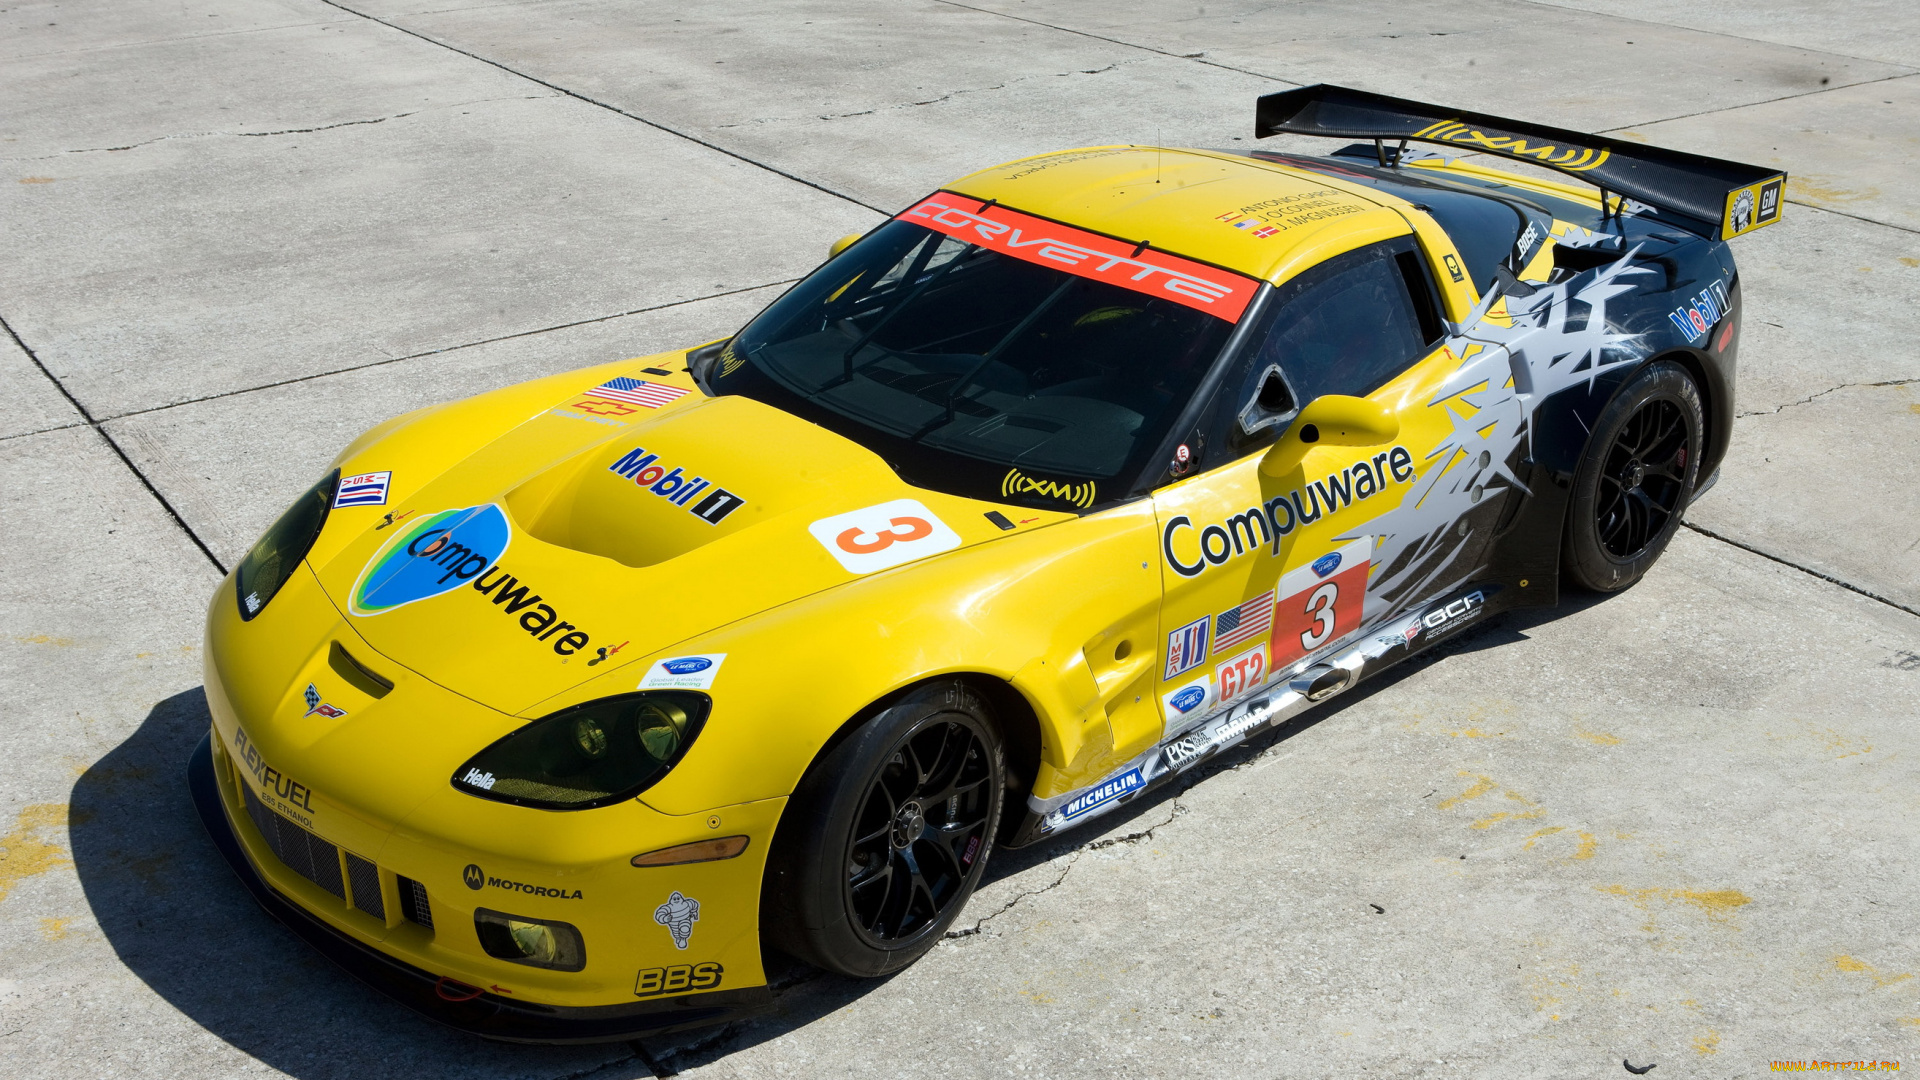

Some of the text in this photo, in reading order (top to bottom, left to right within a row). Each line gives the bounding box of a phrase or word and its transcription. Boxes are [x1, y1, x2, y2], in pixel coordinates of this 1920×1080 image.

[1452, 131, 1555, 159] XM
[1240, 195, 1301, 215] ANTONIO
[1287, 204, 1366, 227] MAGNUSSEN
[1762, 187, 1778, 210] GM
[909, 202, 1234, 304] CORVETTE
[1516, 220, 1539, 261] BOSE
[1668, 288, 1721, 343] Mobil
[550, 408, 630, 428] TEAM CHEVY
[1179, 448, 1187, 458] E
[608, 446, 713, 508] Mobil
[1162, 445, 1415, 579] Compuware
[835, 516, 934, 555] 3
[407, 529, 590, 656] Compuware
[1300, 581, 1339, 651] 3
[1168, 633, 1182, 676] IMSA
[1220, 652, 1264, 702] GT2
[1165, 736, 1196, 763] PRS
[234, 726, 315, 815] FLEXFUEL
[462, 767, 497, 790] Hella
[261, 792, 314, 830] E85 ETHANOL
[1067, 772, 1137, 815] MICHELIN
[964, 836, 979, 864] BBS
[487, 876, 583, 900] MOTOROLA
[634, 962, 724, 997] BBS
